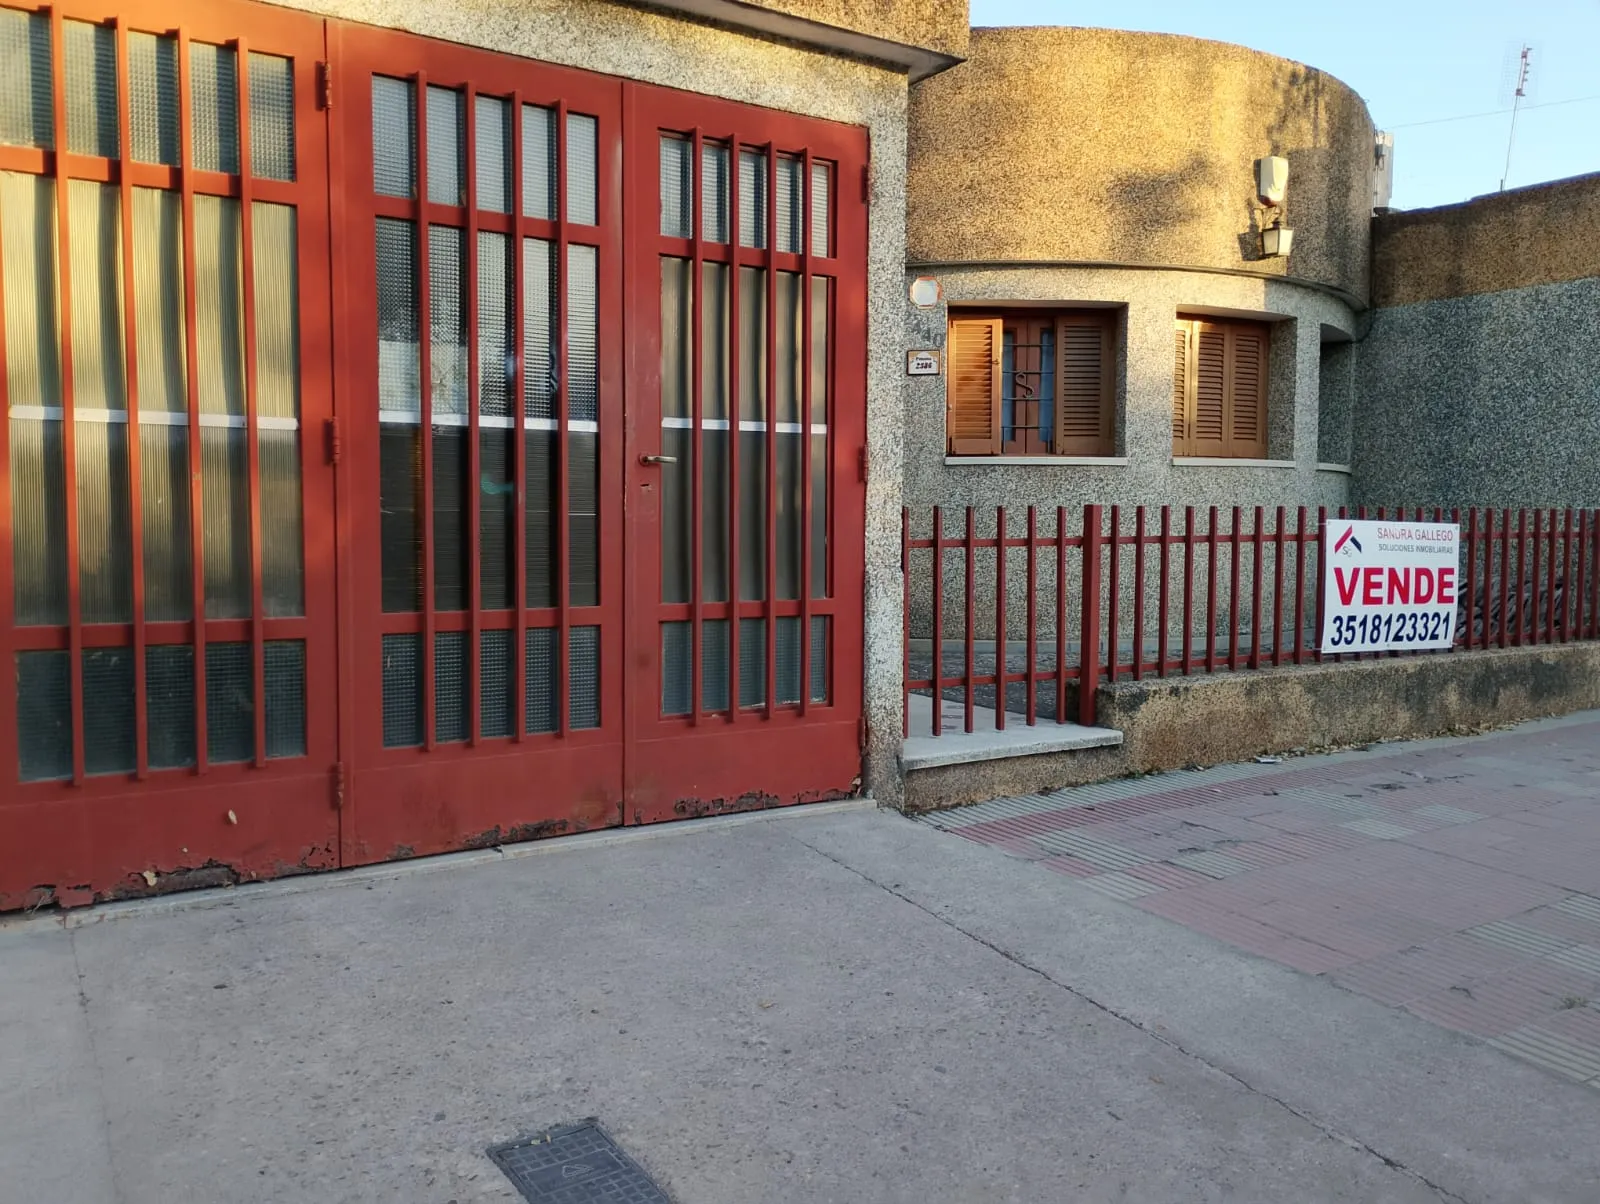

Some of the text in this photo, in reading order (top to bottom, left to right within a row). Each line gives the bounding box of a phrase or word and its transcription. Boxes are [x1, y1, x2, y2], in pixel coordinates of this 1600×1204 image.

[1415, 529, 1453, 542] GALLEGO
[1378, 543, 1453, 554] SOLUCIONES INMOBILIARIAS
[1333, 567, 1455, 605] VENDE
[1330, 611, 1450, 646] 3518123321
